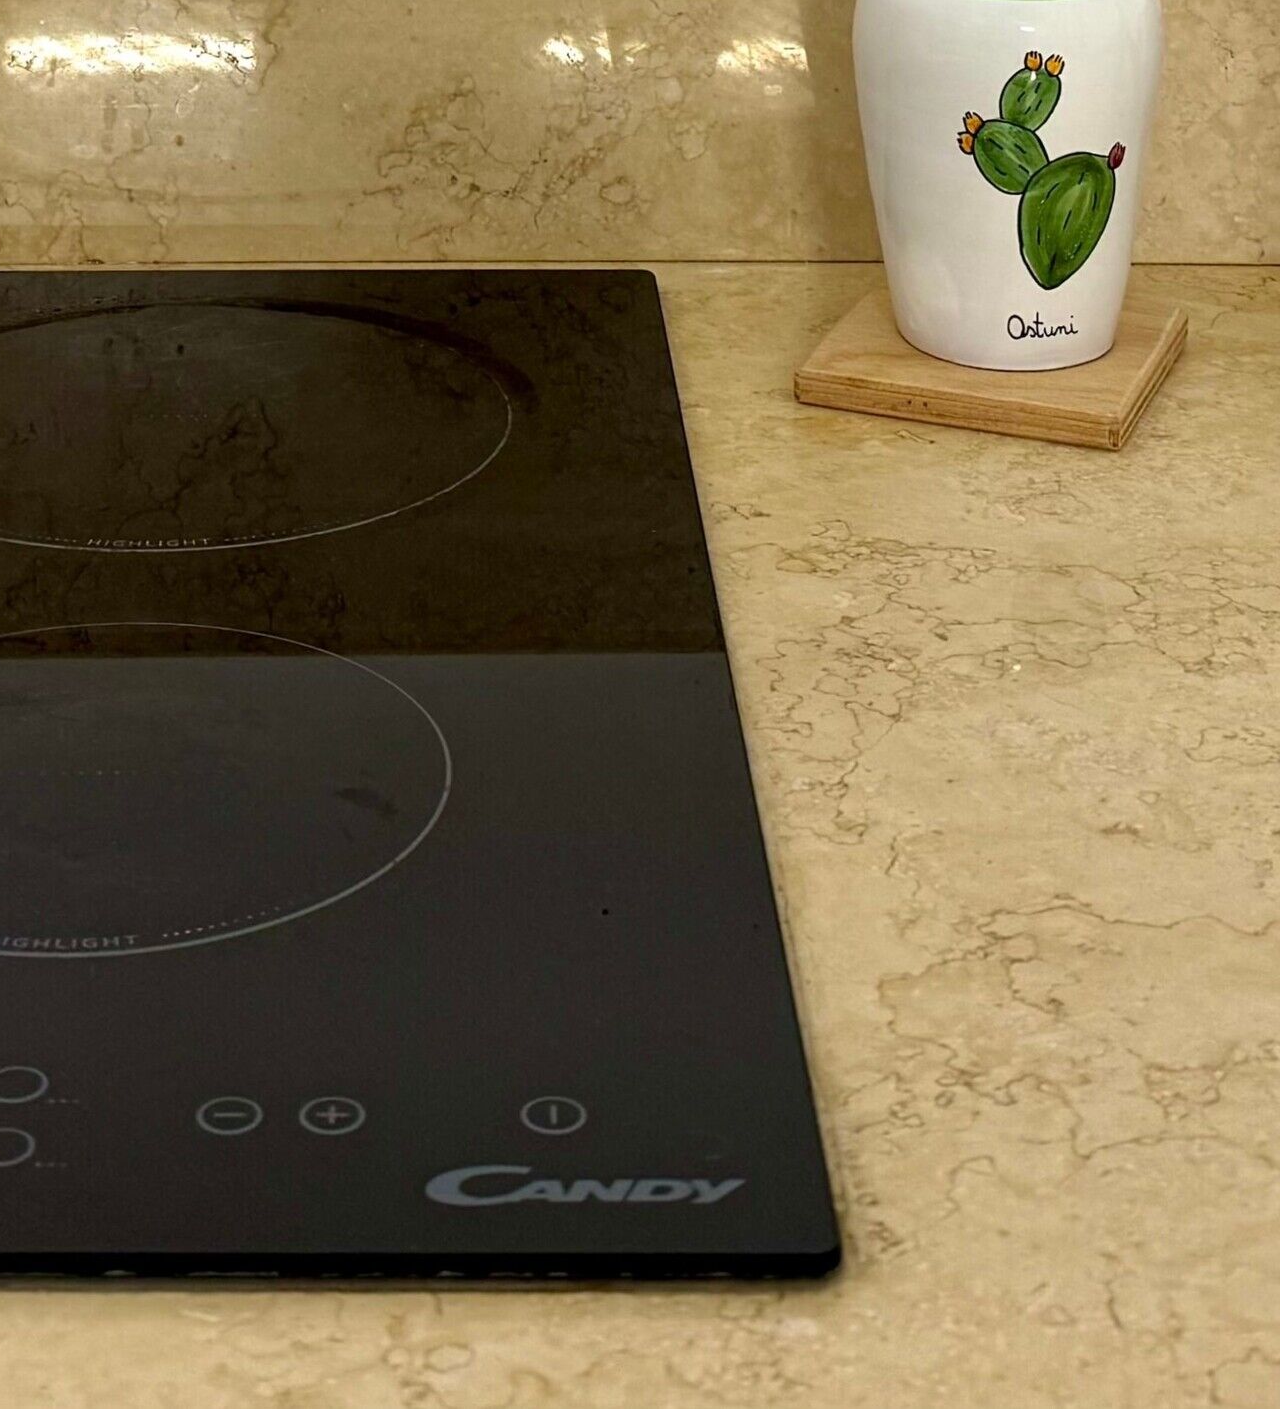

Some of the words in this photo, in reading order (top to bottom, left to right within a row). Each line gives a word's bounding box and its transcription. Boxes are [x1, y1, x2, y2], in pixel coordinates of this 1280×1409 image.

[1007, 311, 1078, 340] Ostuni
[86, 538, 209, 547] HIGHLIGHT
[425, 1164, 746, 1206] CANDY
